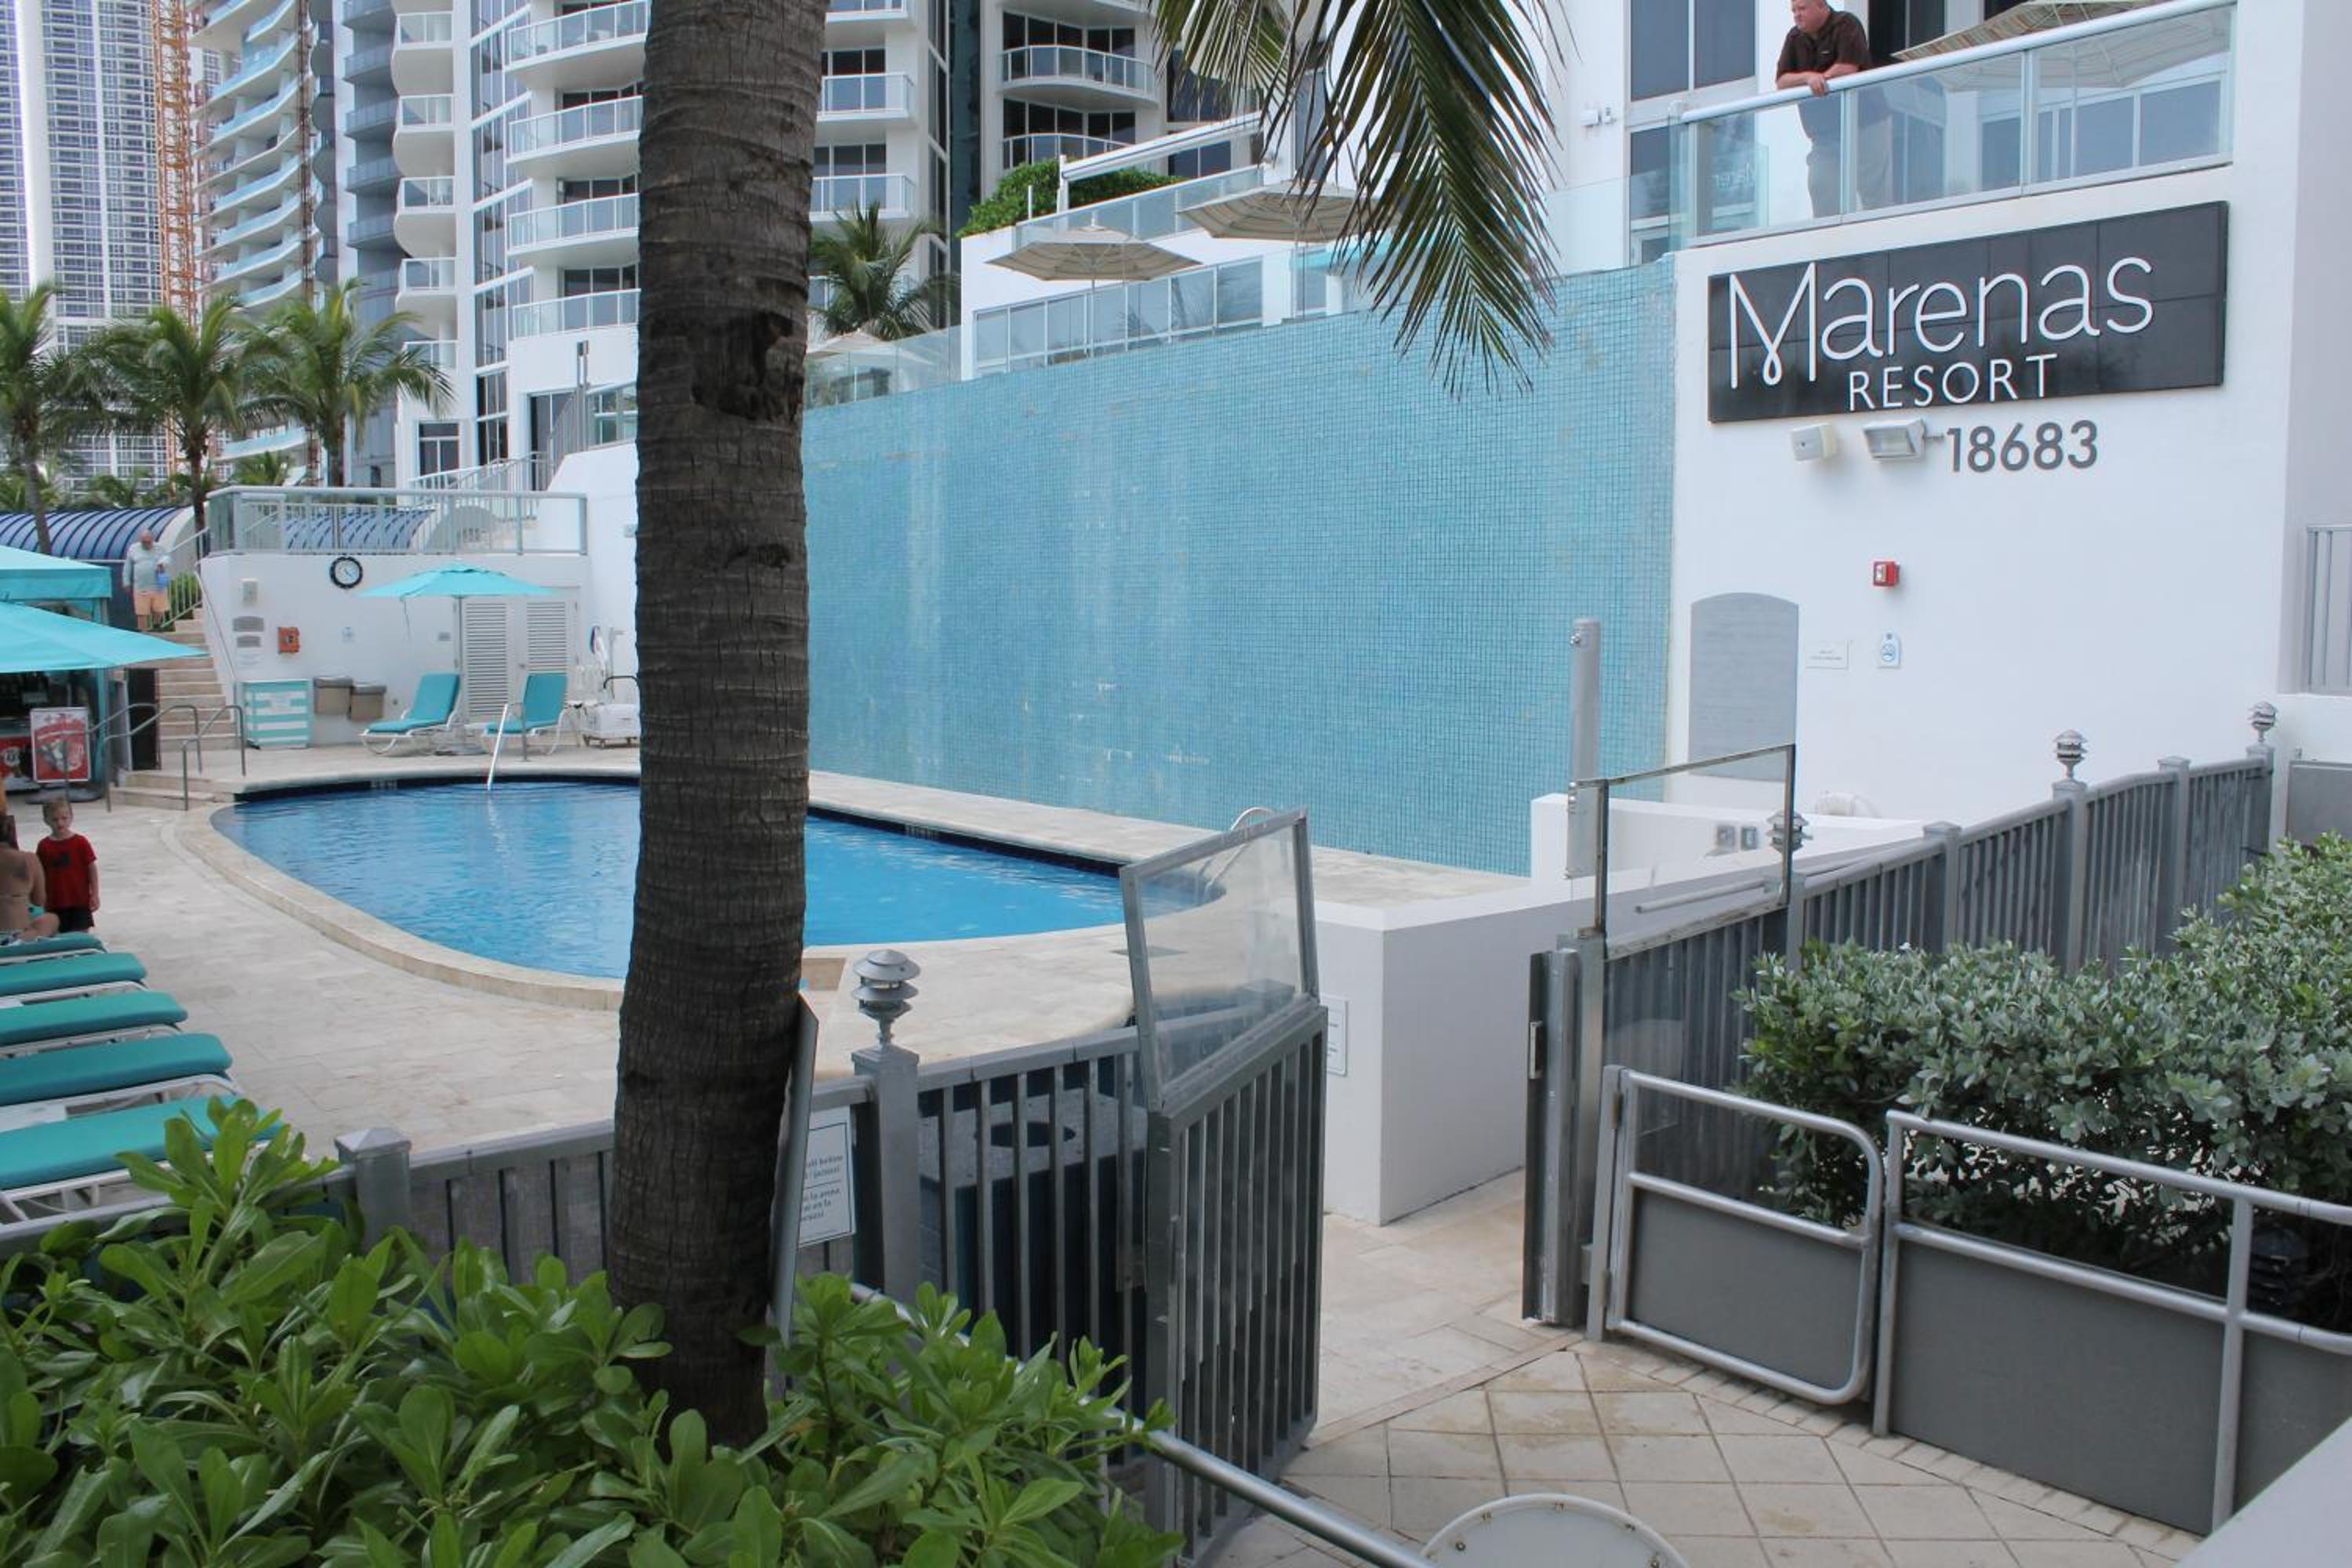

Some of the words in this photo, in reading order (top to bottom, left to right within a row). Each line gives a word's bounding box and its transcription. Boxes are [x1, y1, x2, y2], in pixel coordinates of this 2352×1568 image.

[1729, 256, 2154, 389] Marenas
[1849, 353, 2058, 412] RESORT
[1946, 419, 2099, 474] 18683
